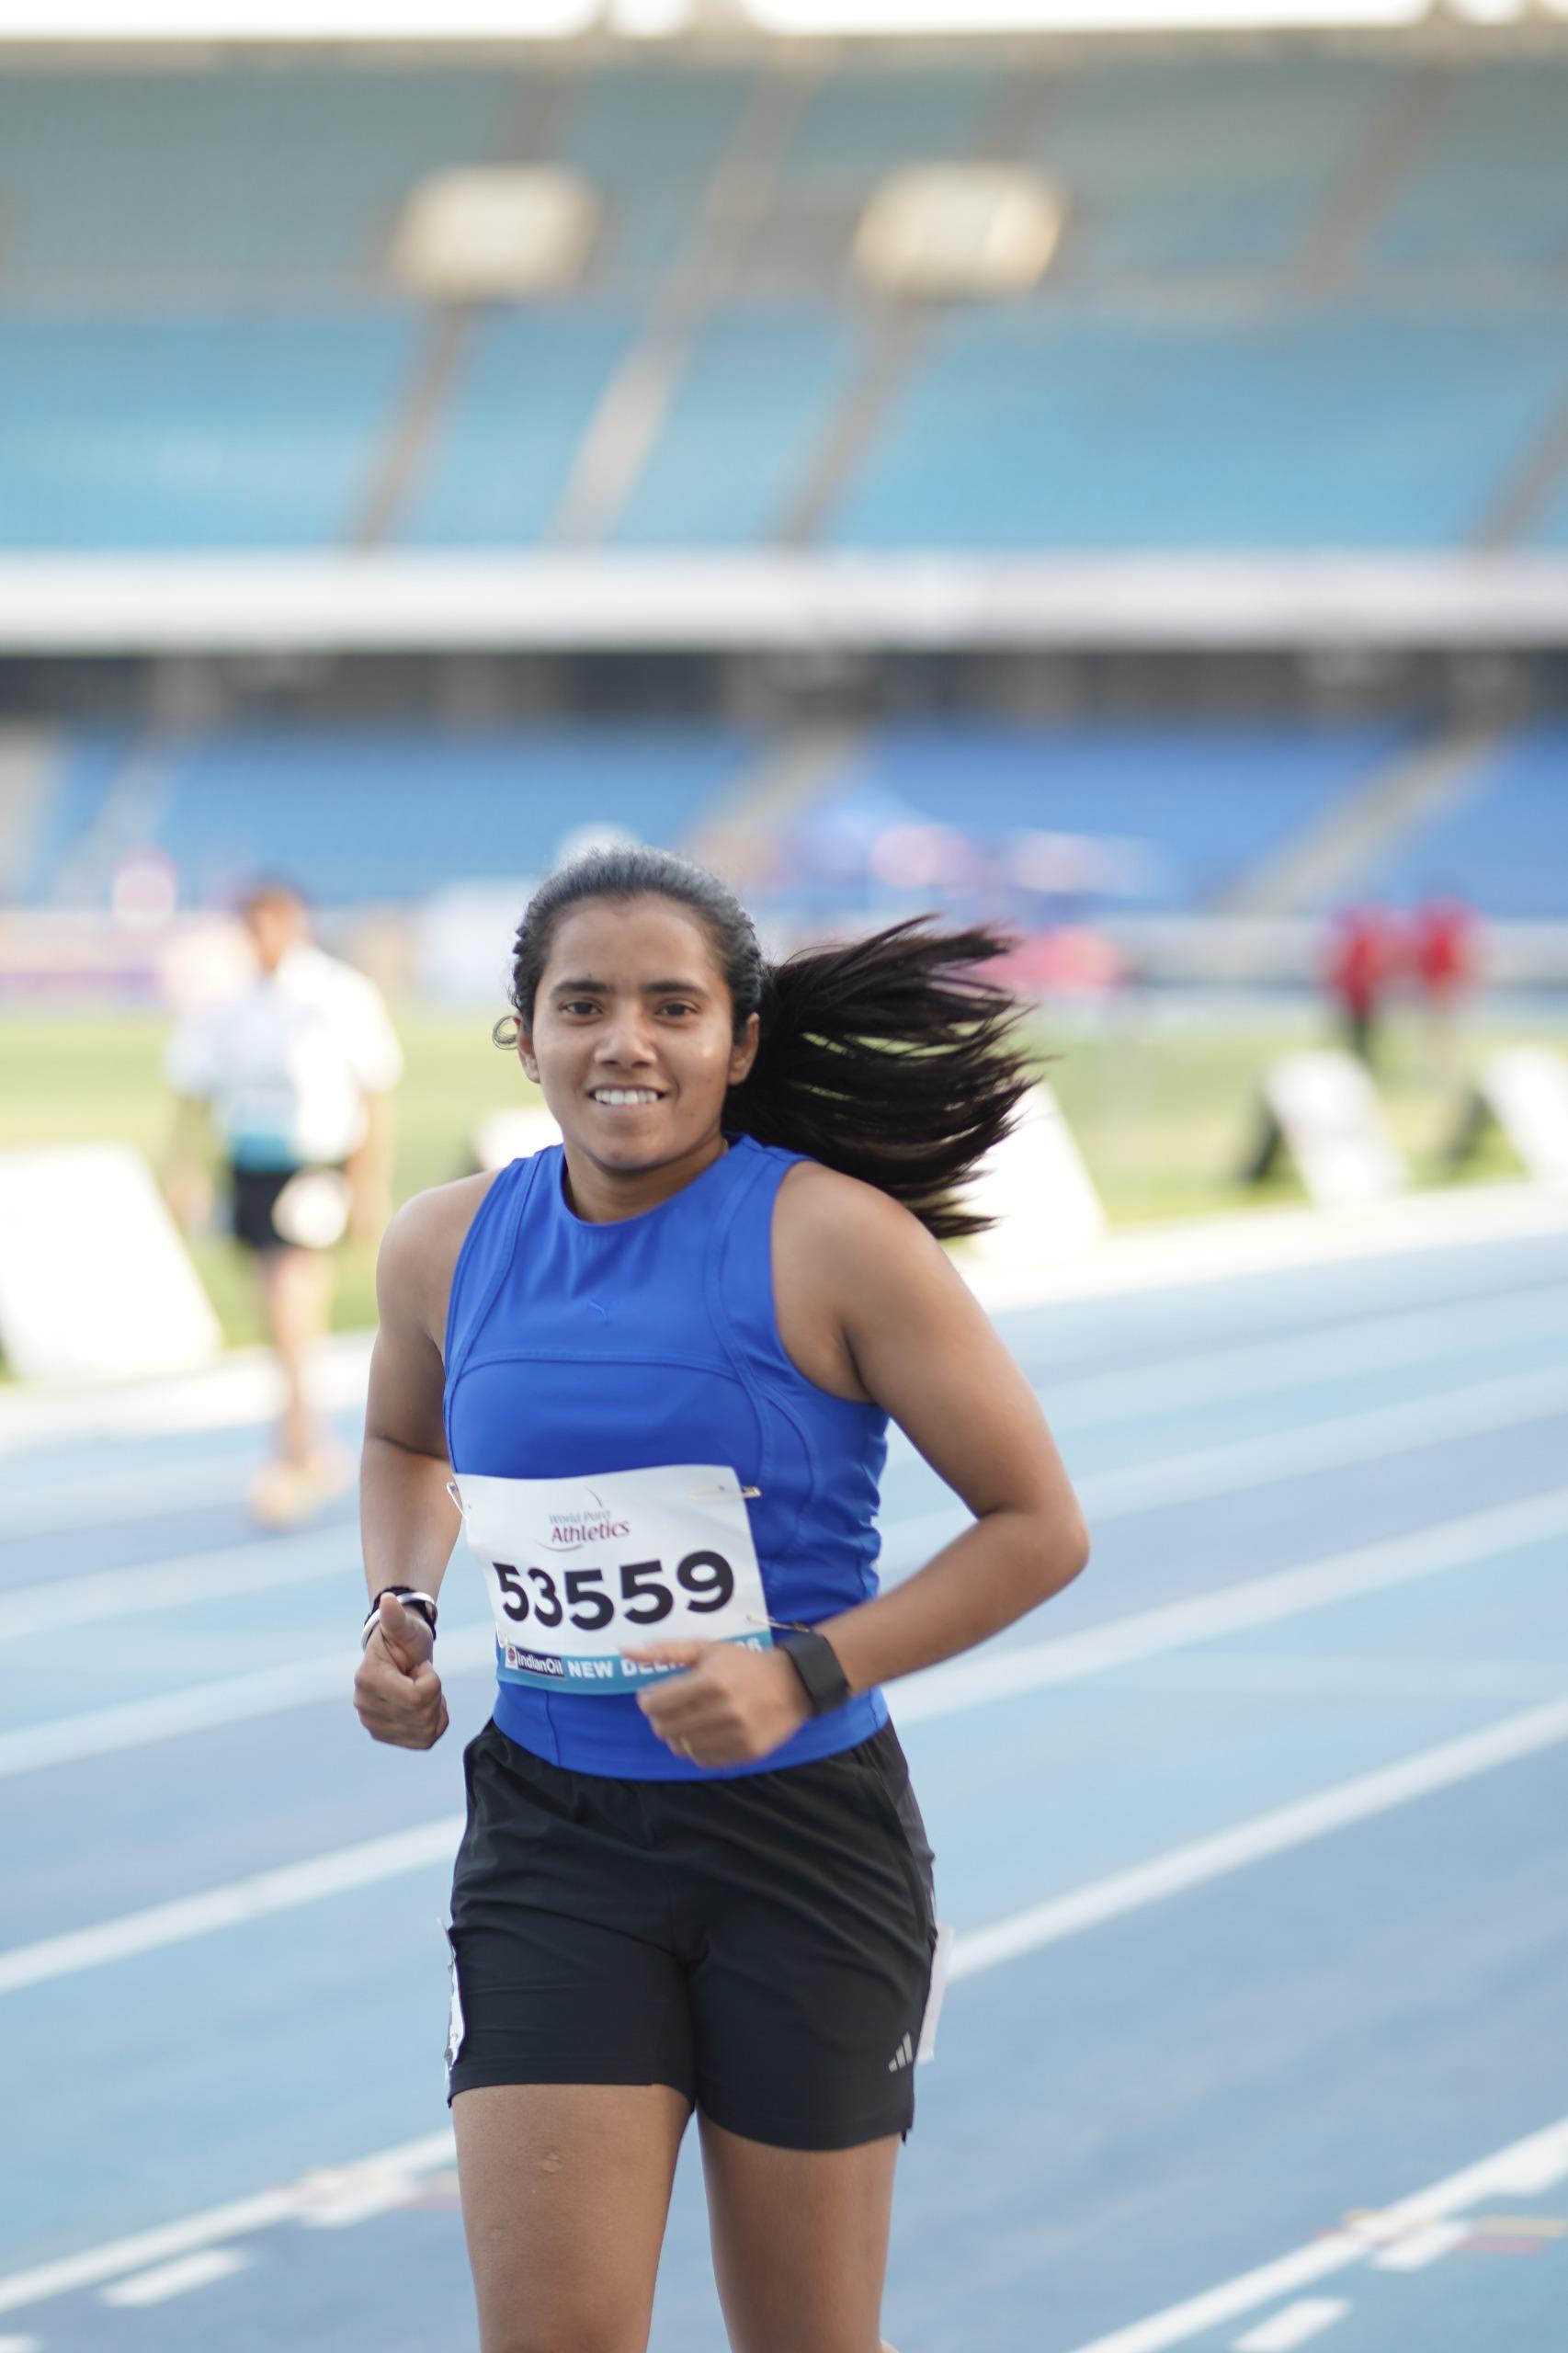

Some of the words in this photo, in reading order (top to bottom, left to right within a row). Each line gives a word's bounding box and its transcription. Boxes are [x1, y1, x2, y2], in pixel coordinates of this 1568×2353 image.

[551, 1520, 631, 1543] Athletics
[492, 1550, 734, 1631] 53559
[517, 1650, 563, 1676] IndianOil
[567, 1660, 613, 1678] NEW
